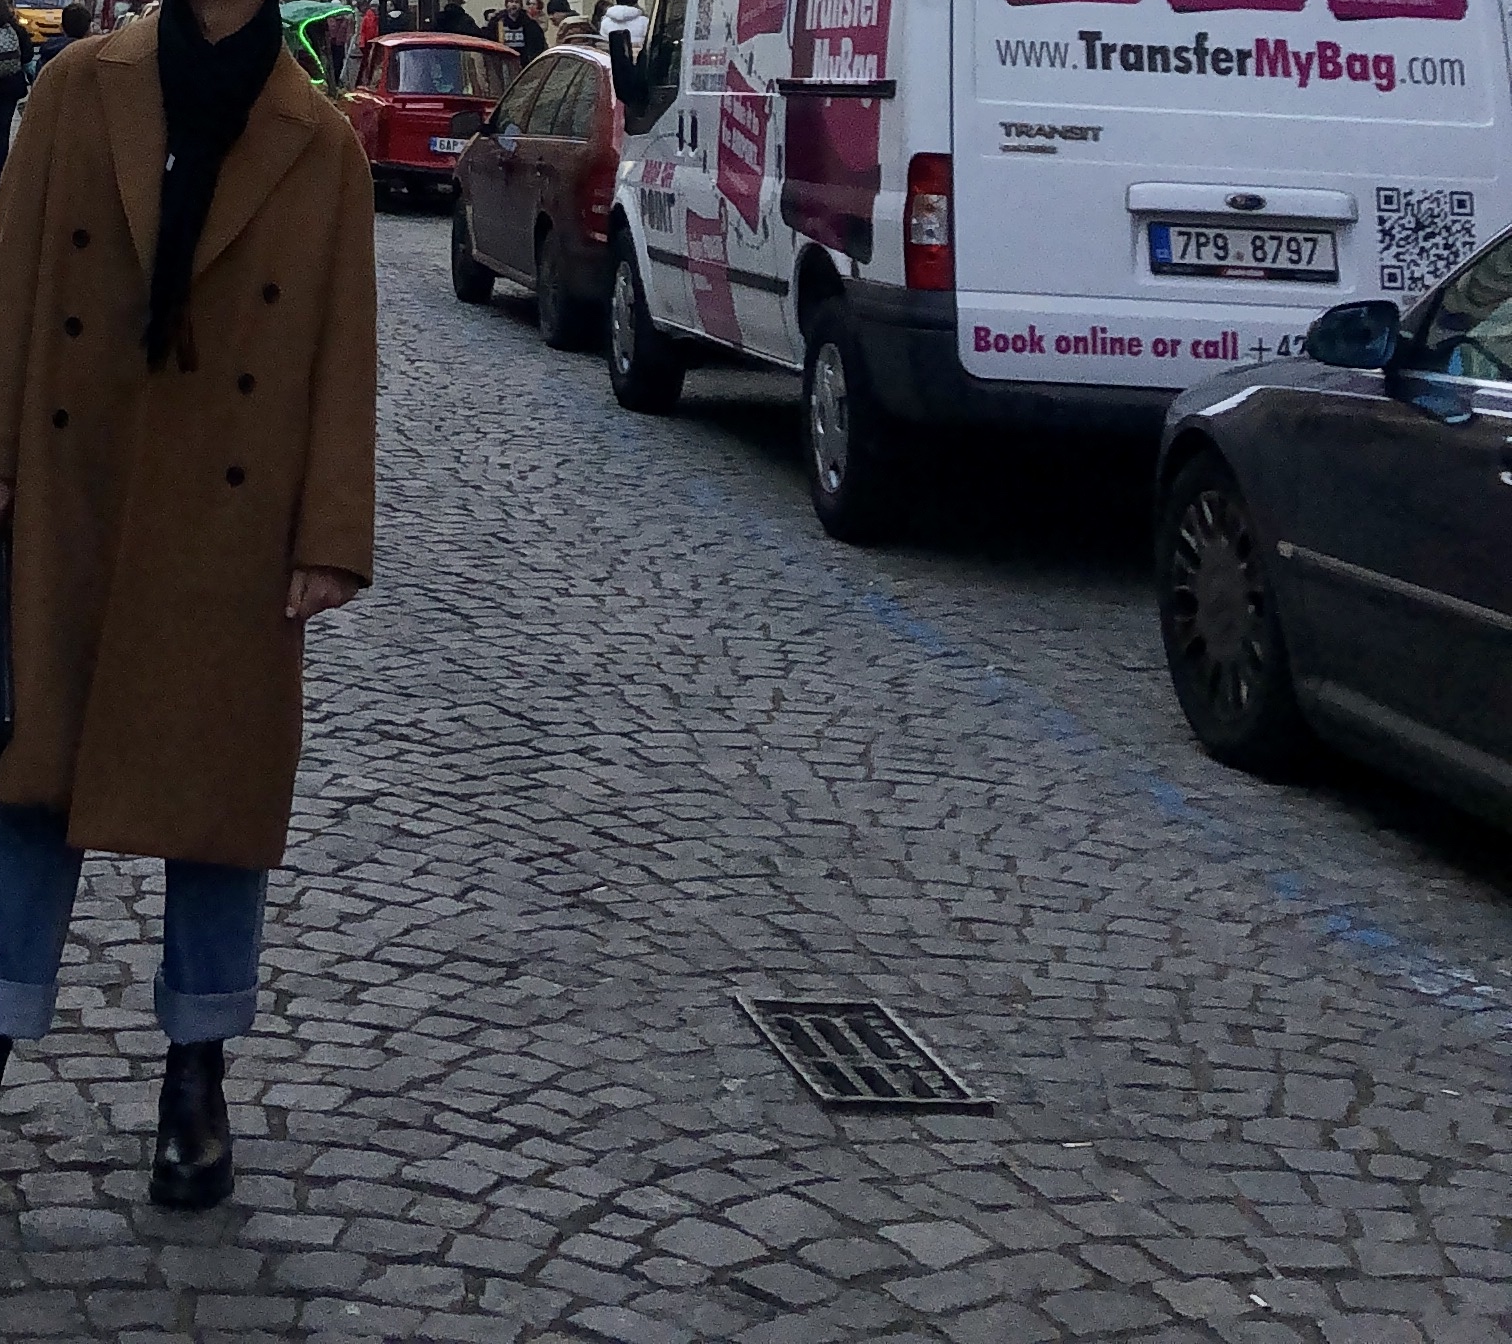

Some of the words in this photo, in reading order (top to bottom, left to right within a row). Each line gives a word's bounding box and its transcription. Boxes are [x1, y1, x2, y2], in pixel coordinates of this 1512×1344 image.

[995, 30, 1466, 93] www.TransferMyBag.com
[998, 121, 1105, 143] TRANSIT
[1176, 230, 1230, 262] 7P9
[1250, 234, 1318, 267] 8797
[973, 324, 1046, 355] Book
[1054, 325, 1144, 358] online
[1151, 336, 1182, 359] or
[1191, 330, 1239, 360] call
